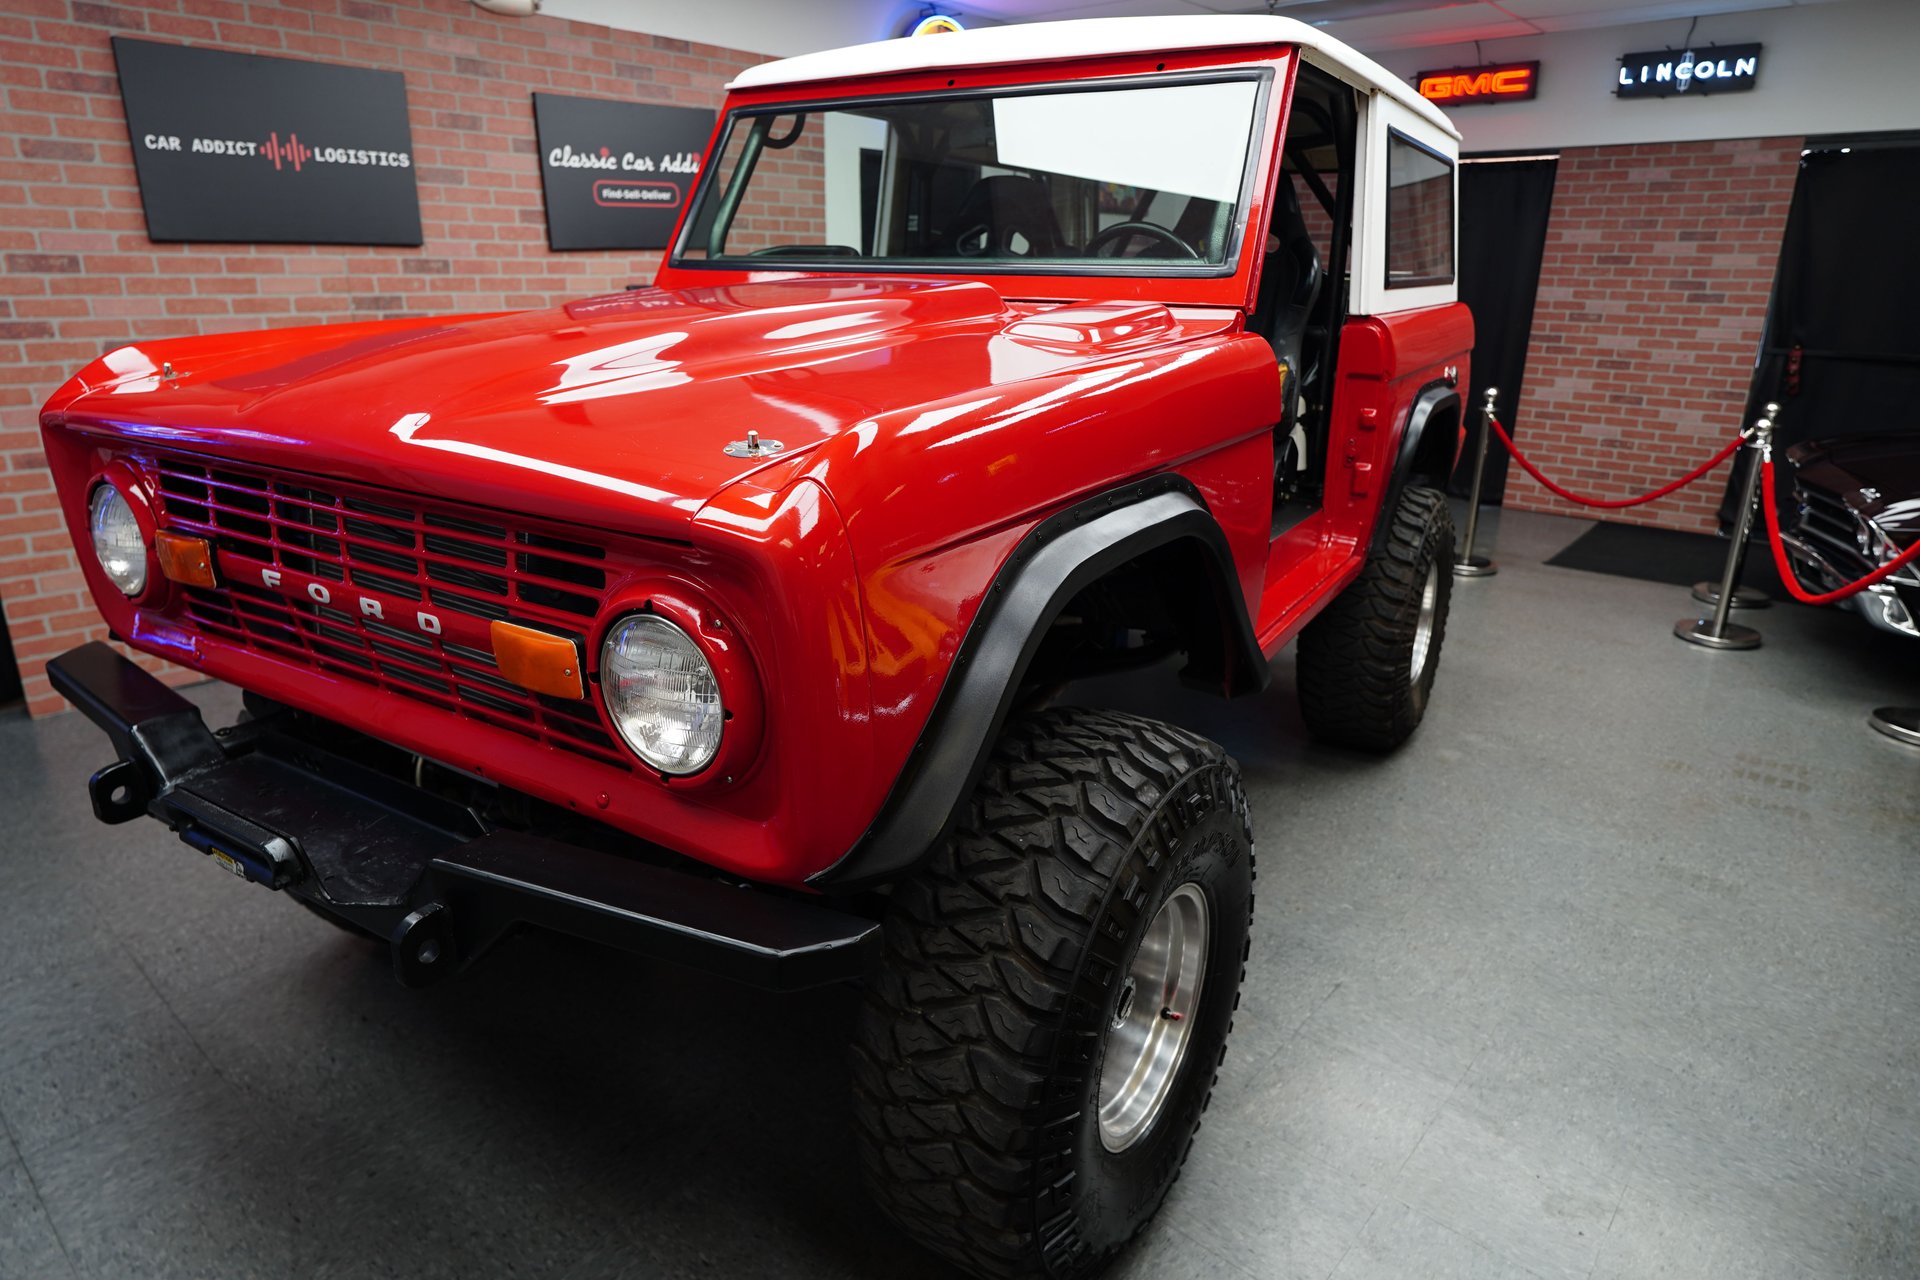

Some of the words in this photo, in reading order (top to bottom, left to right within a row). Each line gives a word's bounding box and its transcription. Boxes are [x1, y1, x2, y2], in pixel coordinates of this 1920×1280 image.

[1420, 69, 1531, 99] GMC
[1619, 57, 1756, 85] LINCOLN
[144, 134, 182, 151] CAR
[192, 138, 257, 156] ADDICT
[314, 146, 411, 168] LOGISTICS
[549, 144, 617, 170] Classic
[621, 152, 655, 172] Car
[659, 152, 702, 173] Addi
[262, 568, 442, 635] FORD
